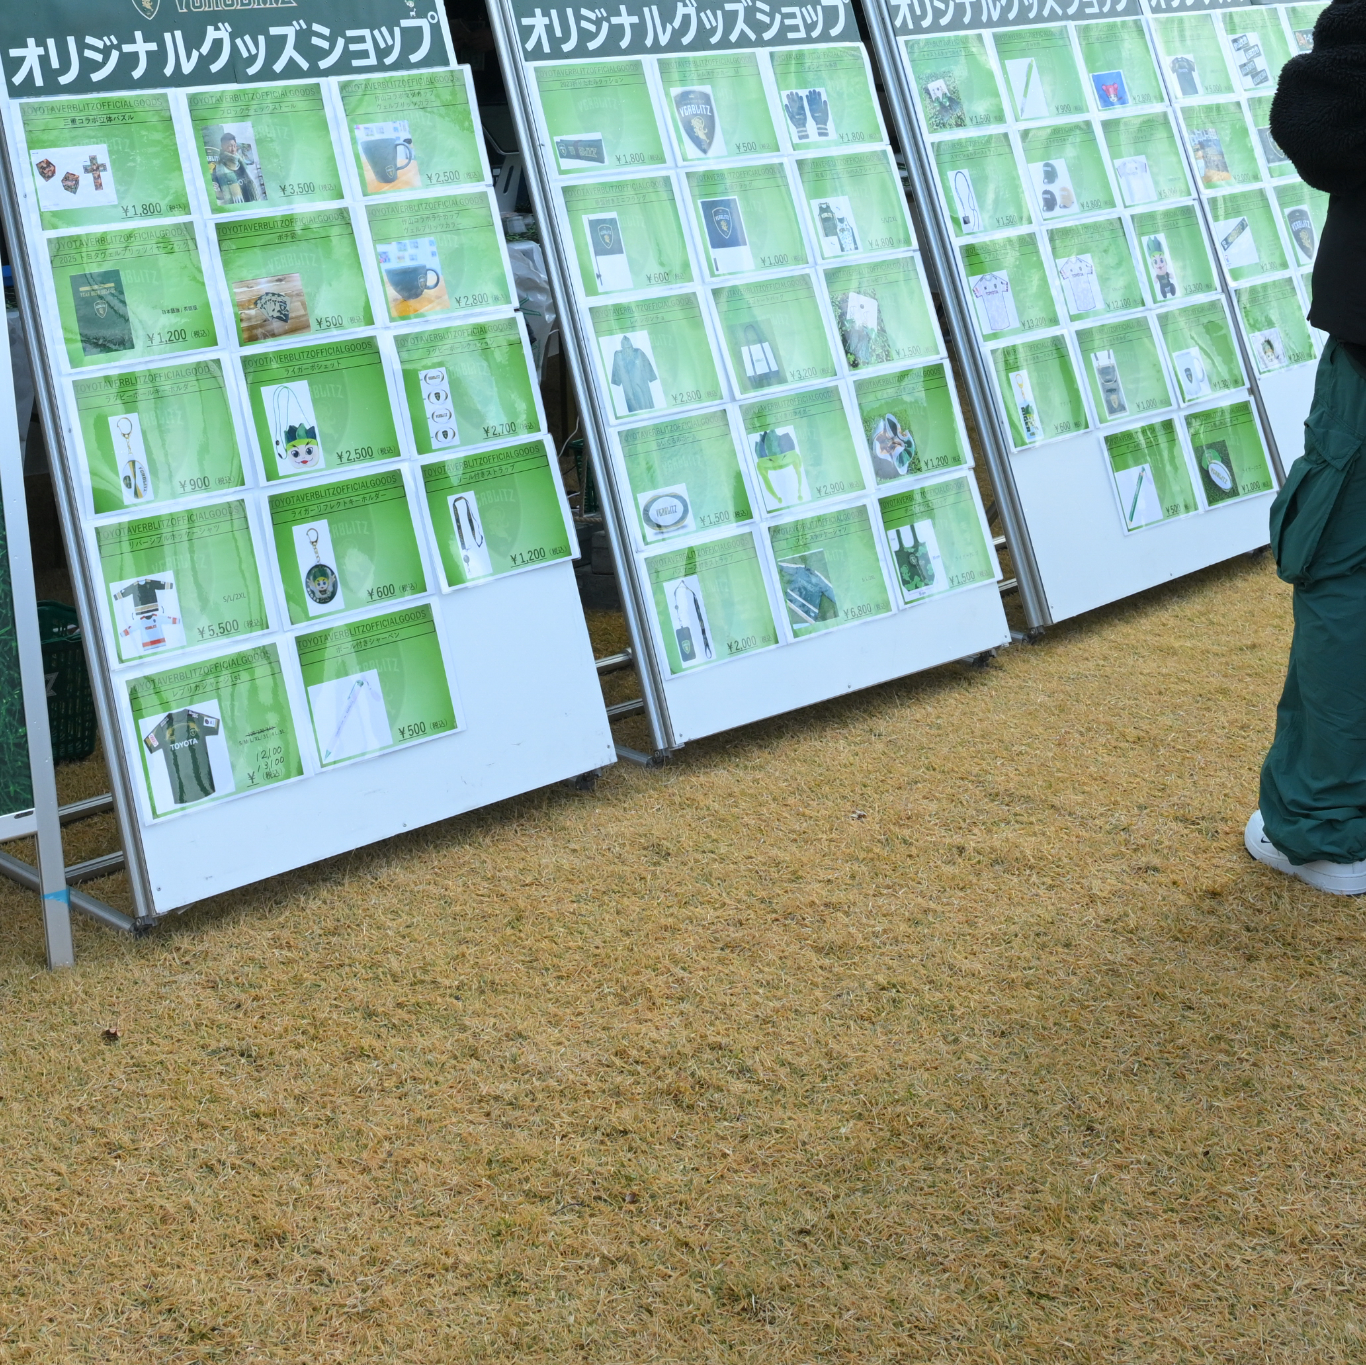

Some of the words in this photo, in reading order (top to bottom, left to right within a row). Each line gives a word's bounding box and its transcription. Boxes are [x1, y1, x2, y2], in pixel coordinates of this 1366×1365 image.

[8, 11, 440, 88] オリジナルグッズショップ
[661, 55, 753, 70] OYOTAVERBLITZOFFICIALGOODS
[220, 101, 297, 115] ブロックチェックストール
[678, 103, 712, 118] VERBLITZ
[1055, 105, 1072, 116] ¥900
[63, 113, 135, 127] 三重コラボ立体パズル
[968, 114, 991, 127] ¥1,500
[839, 131, 866, 144] ¥1,800
[735, 141, 758, 154] ¥500
[615, 151, 646, 166] ¥1,800
[426, 170, 461, 185] ¥2,500
[279, 181, 316, 196] ¥3,500
[121, 202, 163, 217] ¥1,800
[868, 236, 895, 250] ¥4,800
[760, 253, 790, 269] ¥1,000
[646, 271, 671, 286] ¥600
[455, 293, 490, 310] ¥2,800
[1106, 298, 1132, 312] ¥12,100
[316, 315, 344, 331] ¥500
[147, 328, 188, 346] ¥1,200
[242, 340, 372, 368] TOYOTAVERBLITZOFFICIALGOODS
[895, 345, 922, 359] ¥1,500
[789, 367, 818, 382] ¥3,200
[104, 383, 197, 404] ラグビーボールキーホルダー
[672, 389, 703, 407] ¥2,800
[1135, 396, 1159, 411] ¥1,000
[483, 422, 517, 439] ¥2,700
[335, 447, 375, 465] ¥2,500
[923, 455, 950, 471] ¥1,200
[457, 463, 515, 483] リール付きストラップ
[179, 476, 212, 495] ¥900
[270, 474, 397, 510] TOYOTAVERBLITZOFFICIALGOODS
[815, 481, 845, 498] ¥2,900
[1241, 480, 1261, 493] ¥1,000
[291, 492, 387, 519] ライガーリフレクトキーホルダー
[699, 510, 732, 528] ¥1,500
[129, 523, 221, 550] リバーシブルホッケーシャツ
[510, 545, 547, 568] ¥1,200
[948, 570, 976, 588] ¥1,500
[222, 593, 246, 603] S/L/2XL
[366, 582, 396, 603] ¥600
[843, 603, 872, 621] ¥6,800
[196, 618, 241, 642] ¥5,500
[297, 608, 426, 650] TOYOTAVERBLITZOFFICIALGOODS
[336, 631, 400, 654] ボール付きシャーペン
[726, 635, 759, 655] ¥2,000
[398, 721, 427, 743] ¥500
[169, 737, 198, 751] TOYOTA
